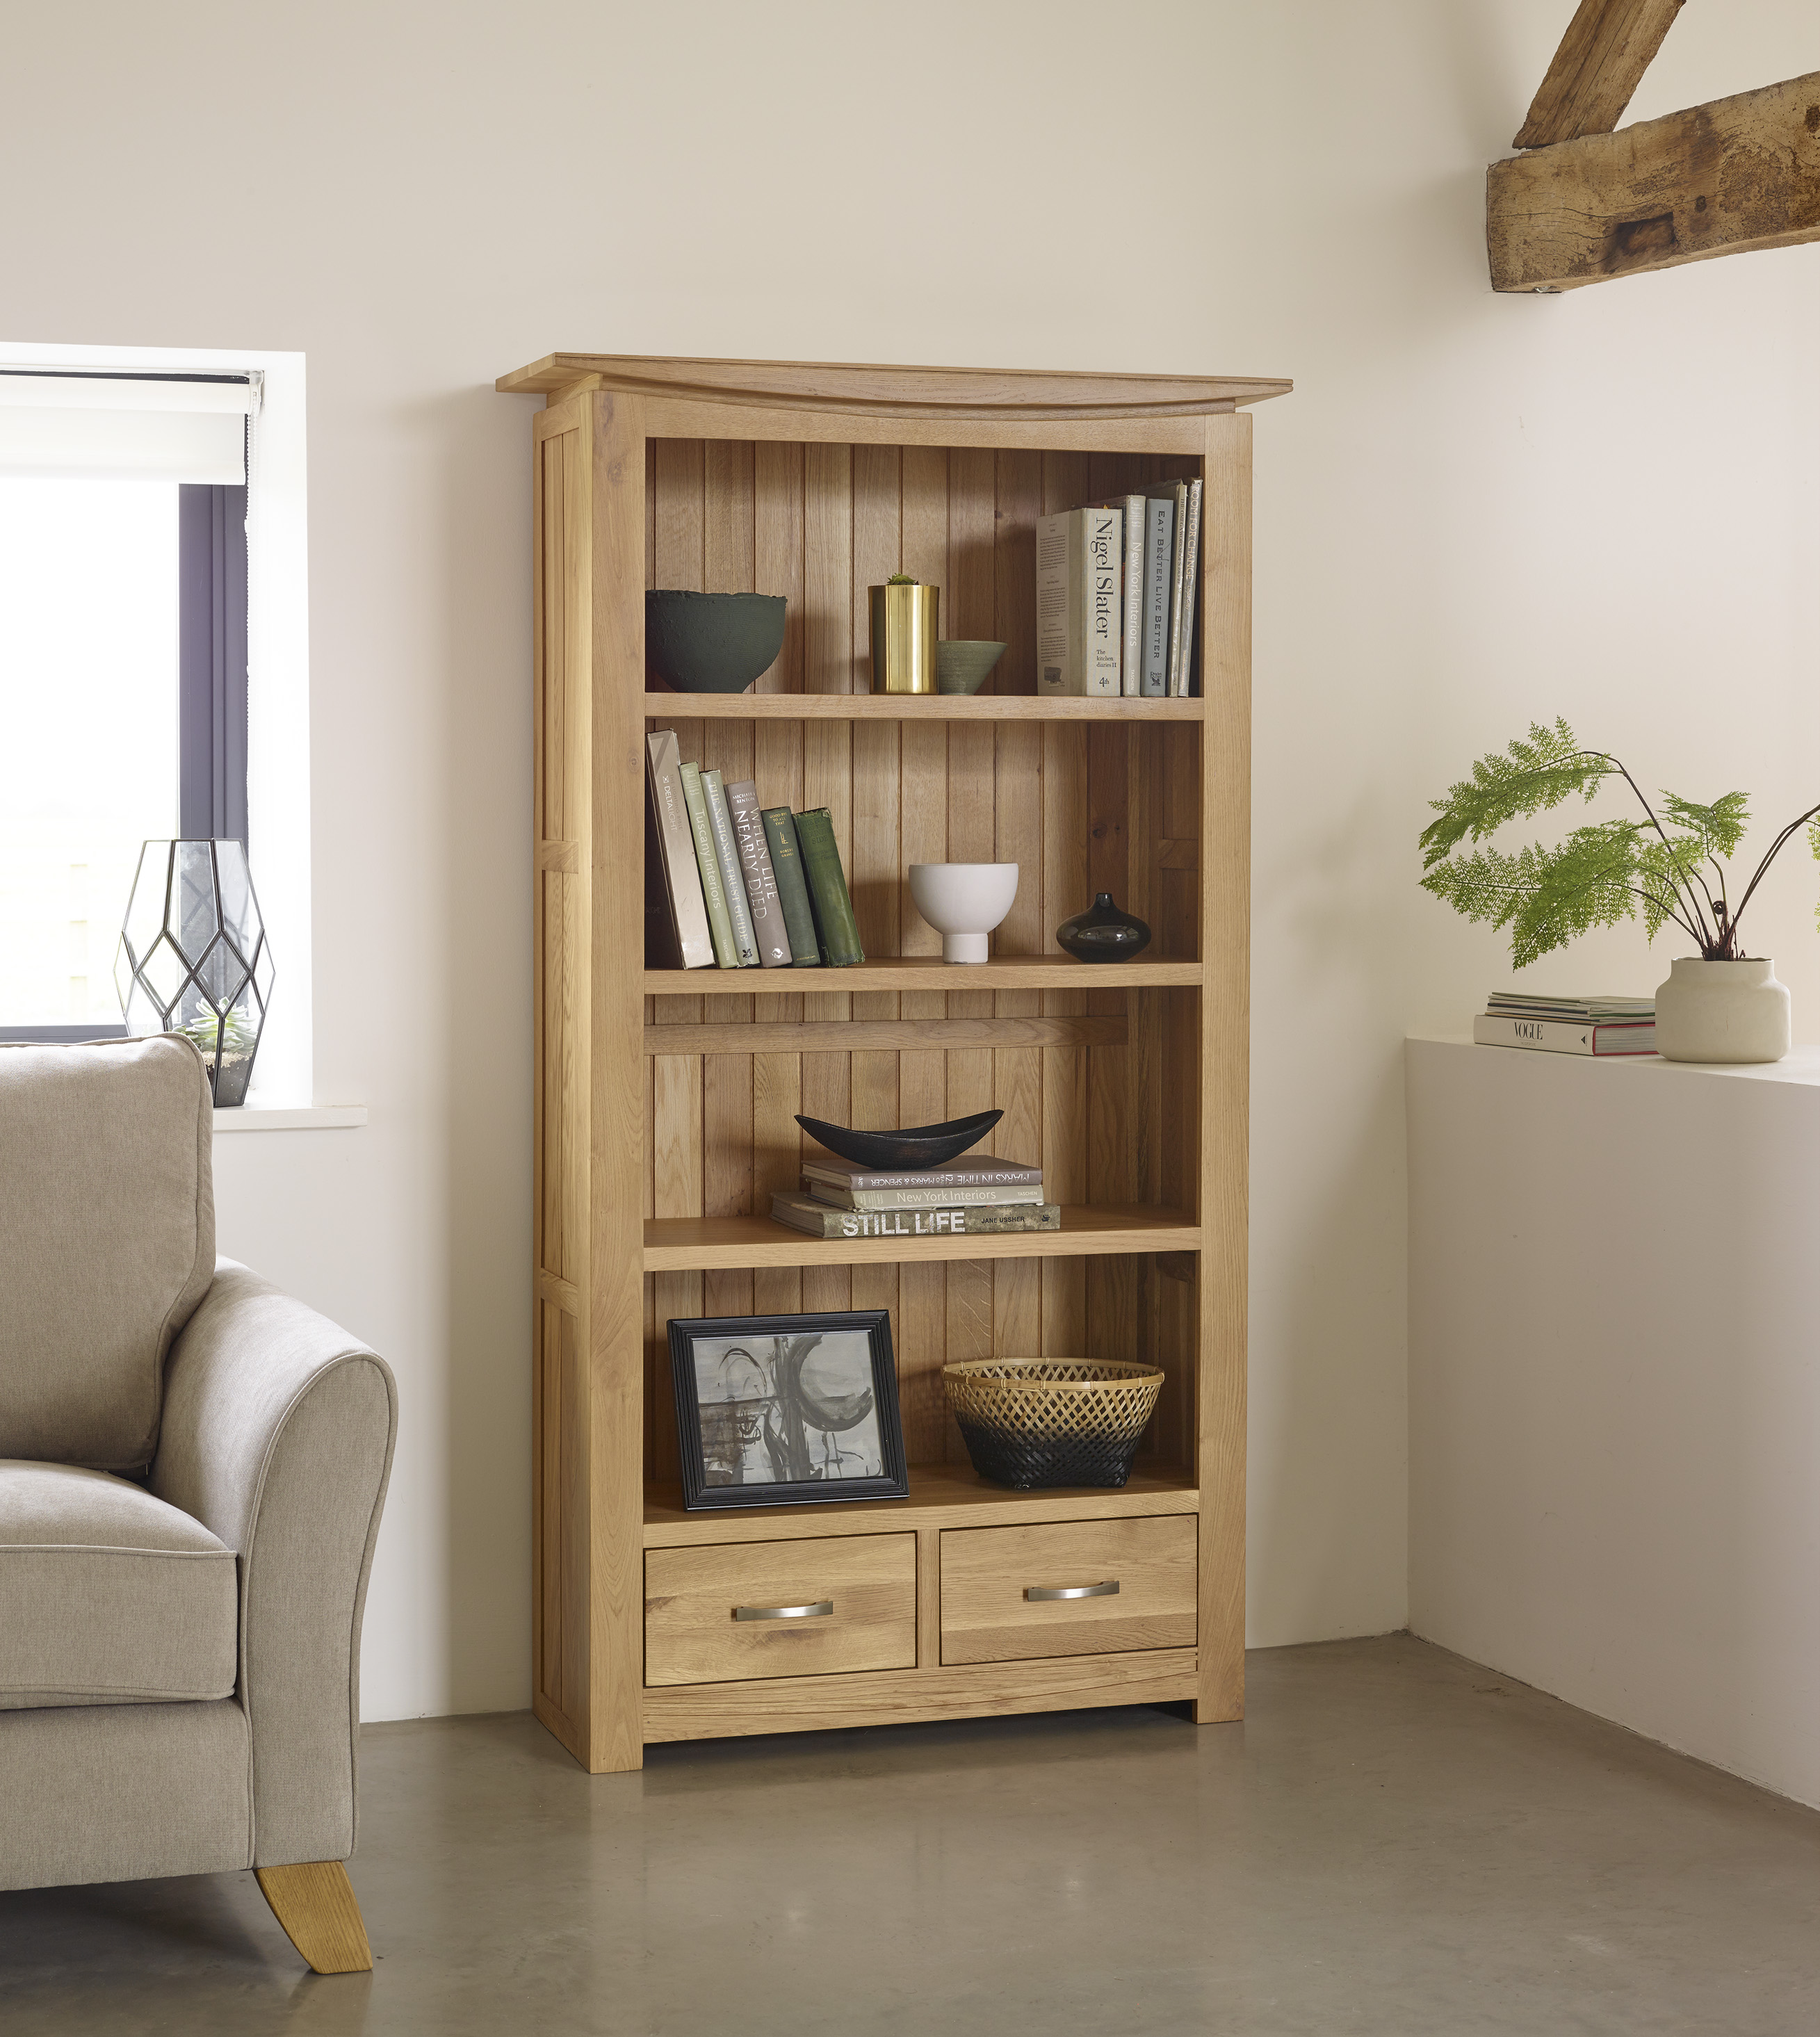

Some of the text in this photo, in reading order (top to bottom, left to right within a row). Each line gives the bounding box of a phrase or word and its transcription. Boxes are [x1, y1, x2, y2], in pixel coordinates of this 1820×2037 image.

[1090, 517, 1114, 638] Nigel Slater
[1155, 539, 1164, 582] BETTER
[1186, 487, 1199, 580] ROOM FOR CHANGE
[1130, 542, 1141, 647] New York Interiors
[664, 786, 677, 831] DELTALIGHT
[751, 806, 778, 899] WHEN LIFE
[695, 809, 721, 909] Tuscany Interiors
[708, 781, 749, 941] THE NATIONAL TRUST GUIDE
[735, 810, 767, 918] NEARLY DIED
[1514, 1022, 1543, 1040] VOGUE
[843, 1212, 966, 1236] STILL LIFE
[897, 1190, 996, 1202] New York Interiors
[957, 1173, 1030, 1185] MARKS IN TIME
